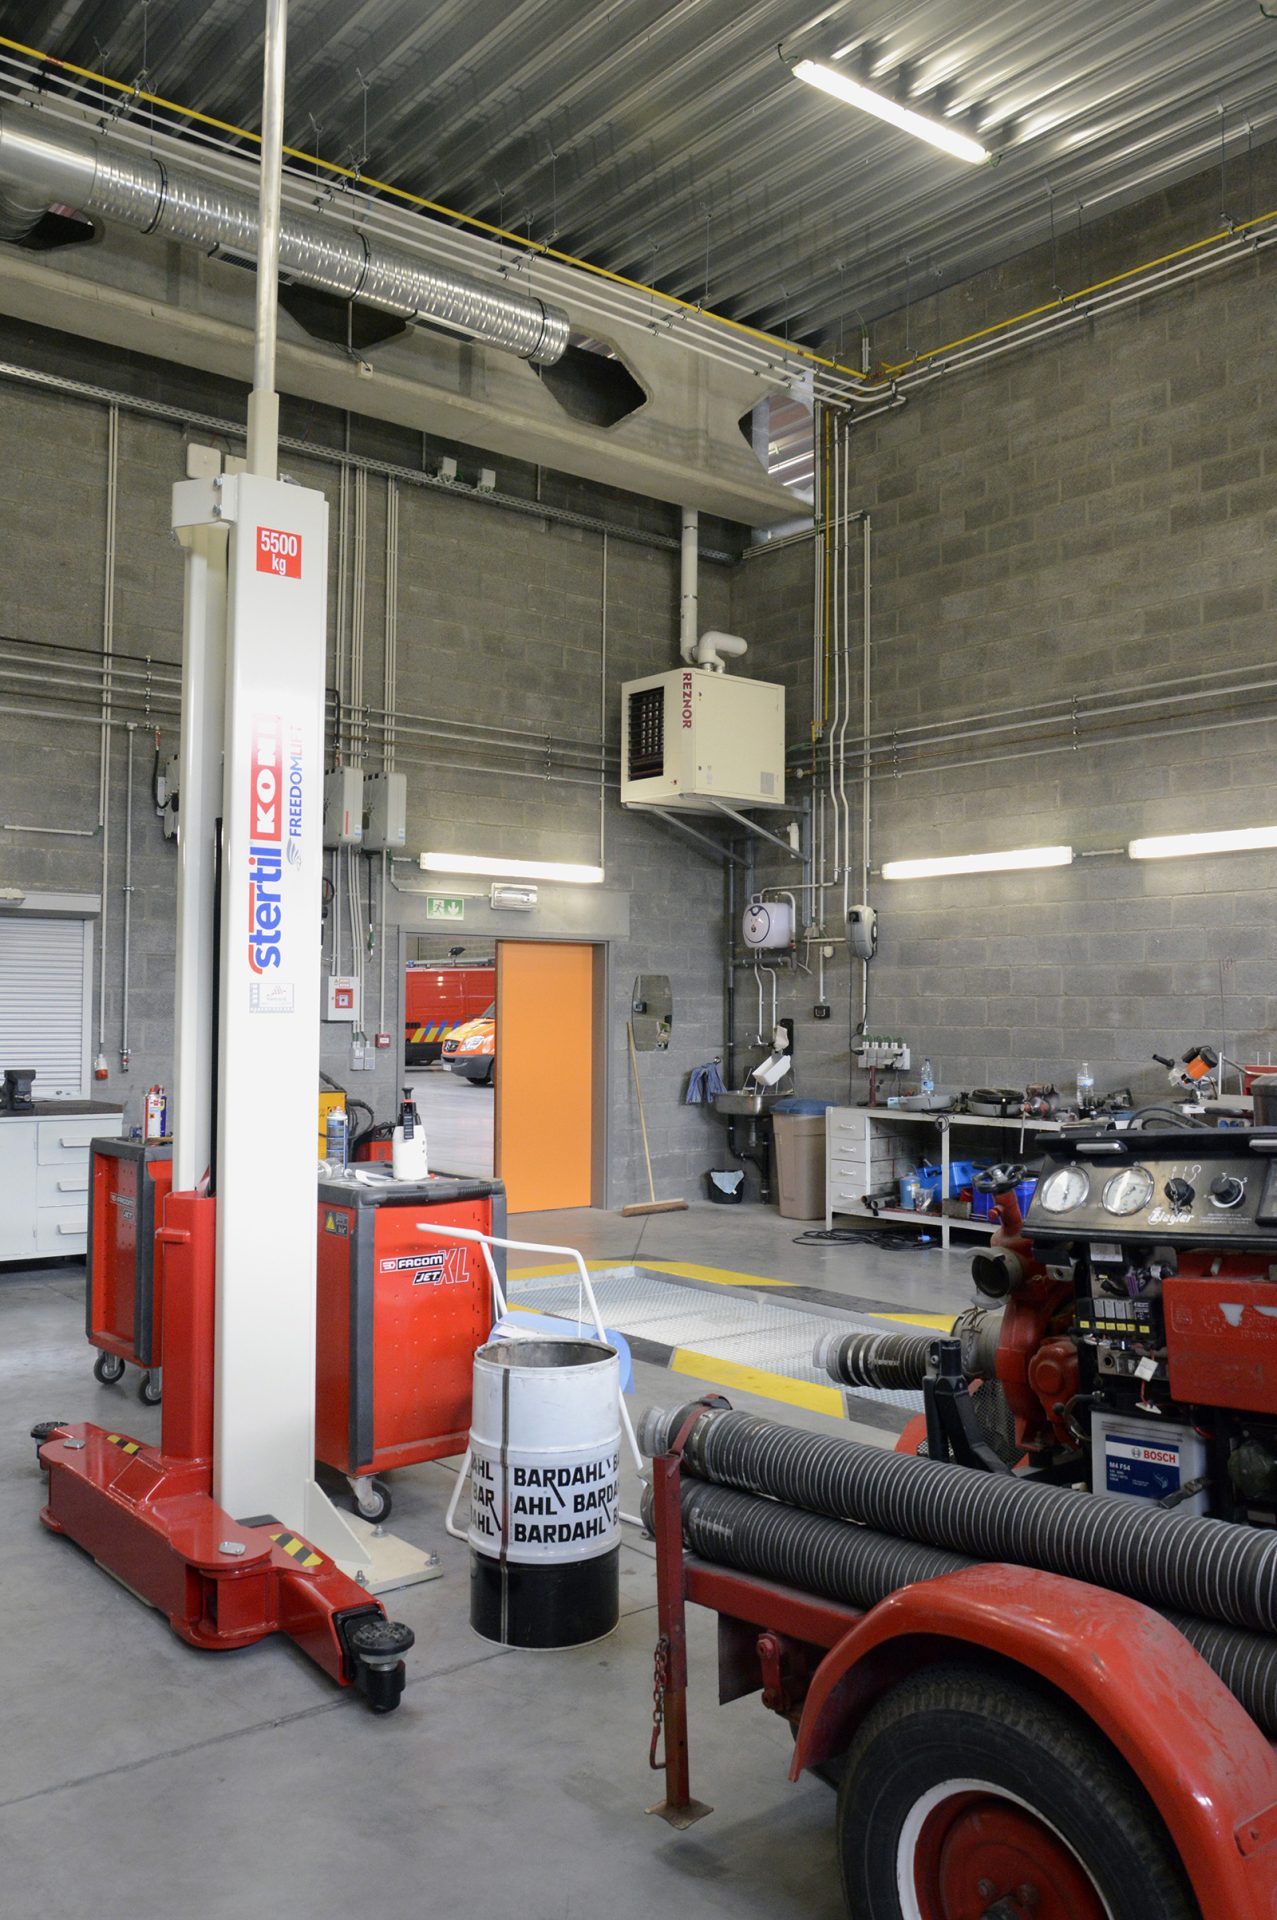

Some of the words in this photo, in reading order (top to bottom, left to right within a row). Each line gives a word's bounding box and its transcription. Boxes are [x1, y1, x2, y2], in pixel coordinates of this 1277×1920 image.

[260, 530, 298, 557] 5500
[272, 553, 287, 576] kg
[682, 672, 693, 729] REZNOR
[248, 846, 282, 975] stertil
[398, 1255, 443, 1269] FACOM
[415, 1271, 441, 1283] JET
[434, 1247, 470, 1286] XL
[1143, 1449, 1176, 1463] BOSCH
[513, 1462, 606, 1508] BARDAHL
[513, 1495, 558, 1516] AHL
[513, 1515, 607, 1544] BARDAHL
